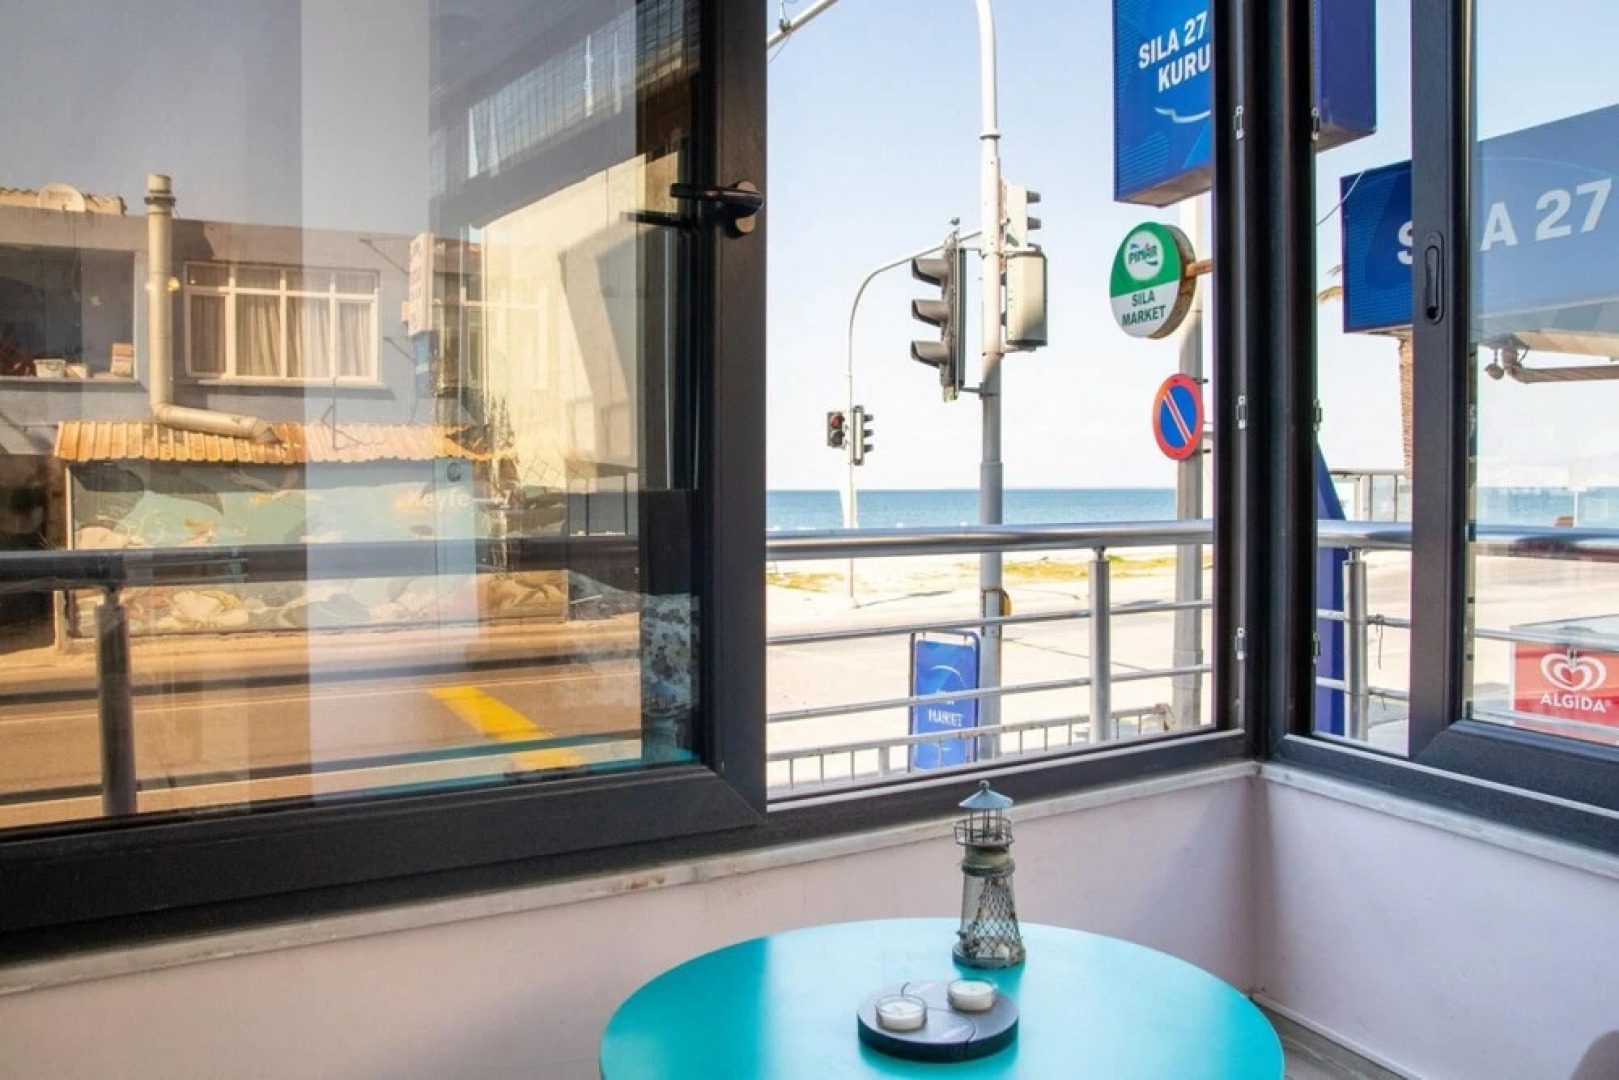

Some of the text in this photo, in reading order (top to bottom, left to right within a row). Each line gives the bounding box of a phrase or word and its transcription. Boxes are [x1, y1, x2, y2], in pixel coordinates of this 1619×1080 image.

[1138, 10, 1207, 69] SILA 27
[1536, 178, 1612, 241] 27
[1121, 305, 1166, 326] MARKET
[1131, 289, 1155, 307] SILA
